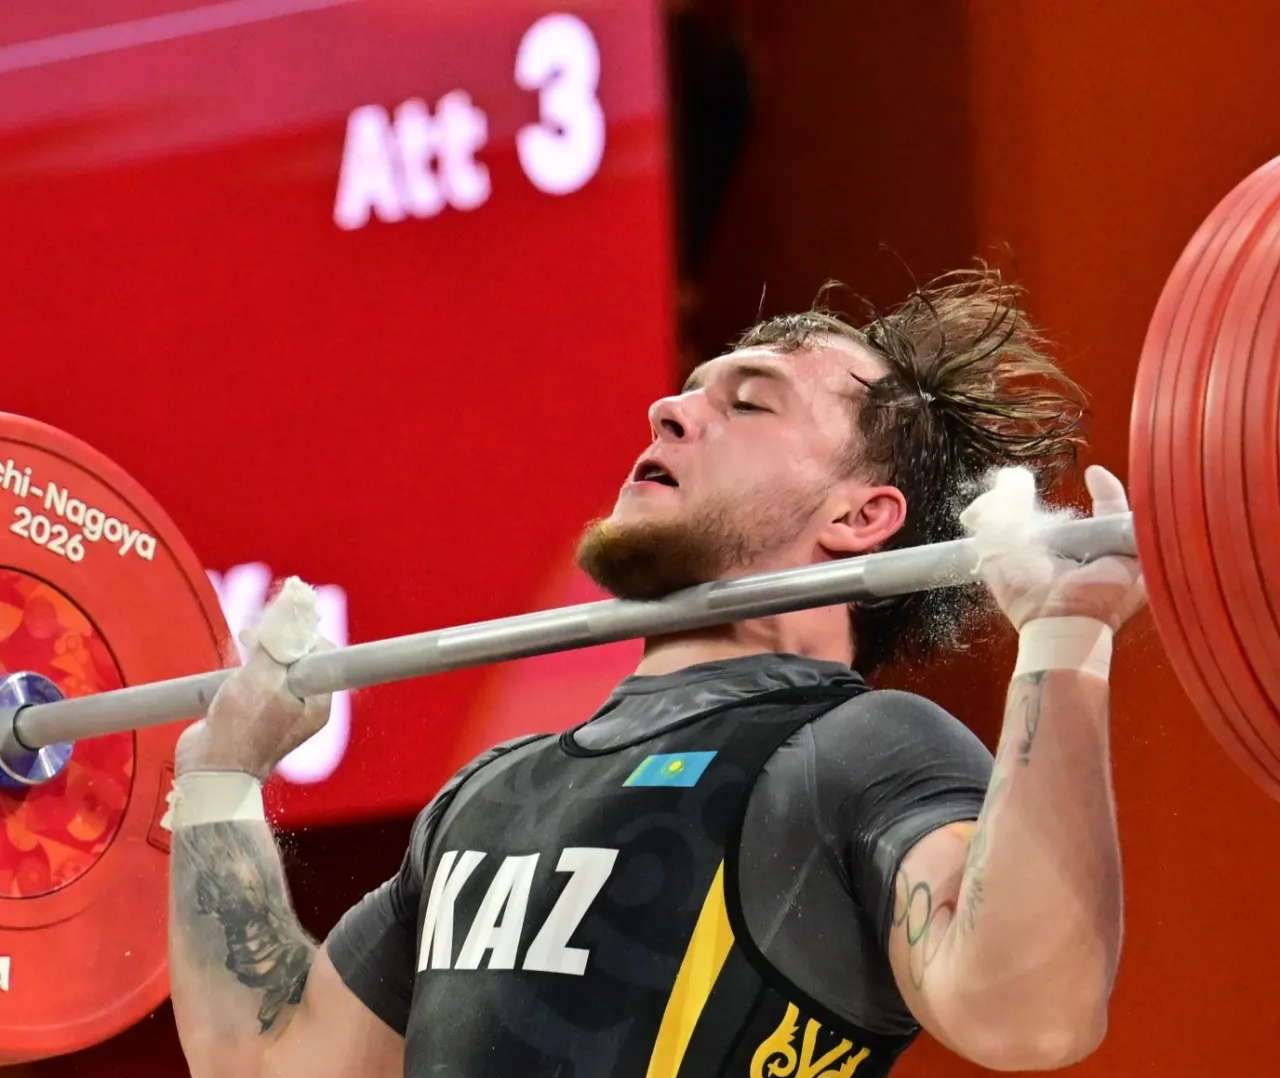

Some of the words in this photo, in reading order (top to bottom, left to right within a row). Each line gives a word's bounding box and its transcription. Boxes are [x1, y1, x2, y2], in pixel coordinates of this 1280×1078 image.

[333, 88, 491, 230] Att
[514, 13, 606, 196] 3
[10, 506, 86, 562] 2026
[417, 847, 619, 976] KAZ
